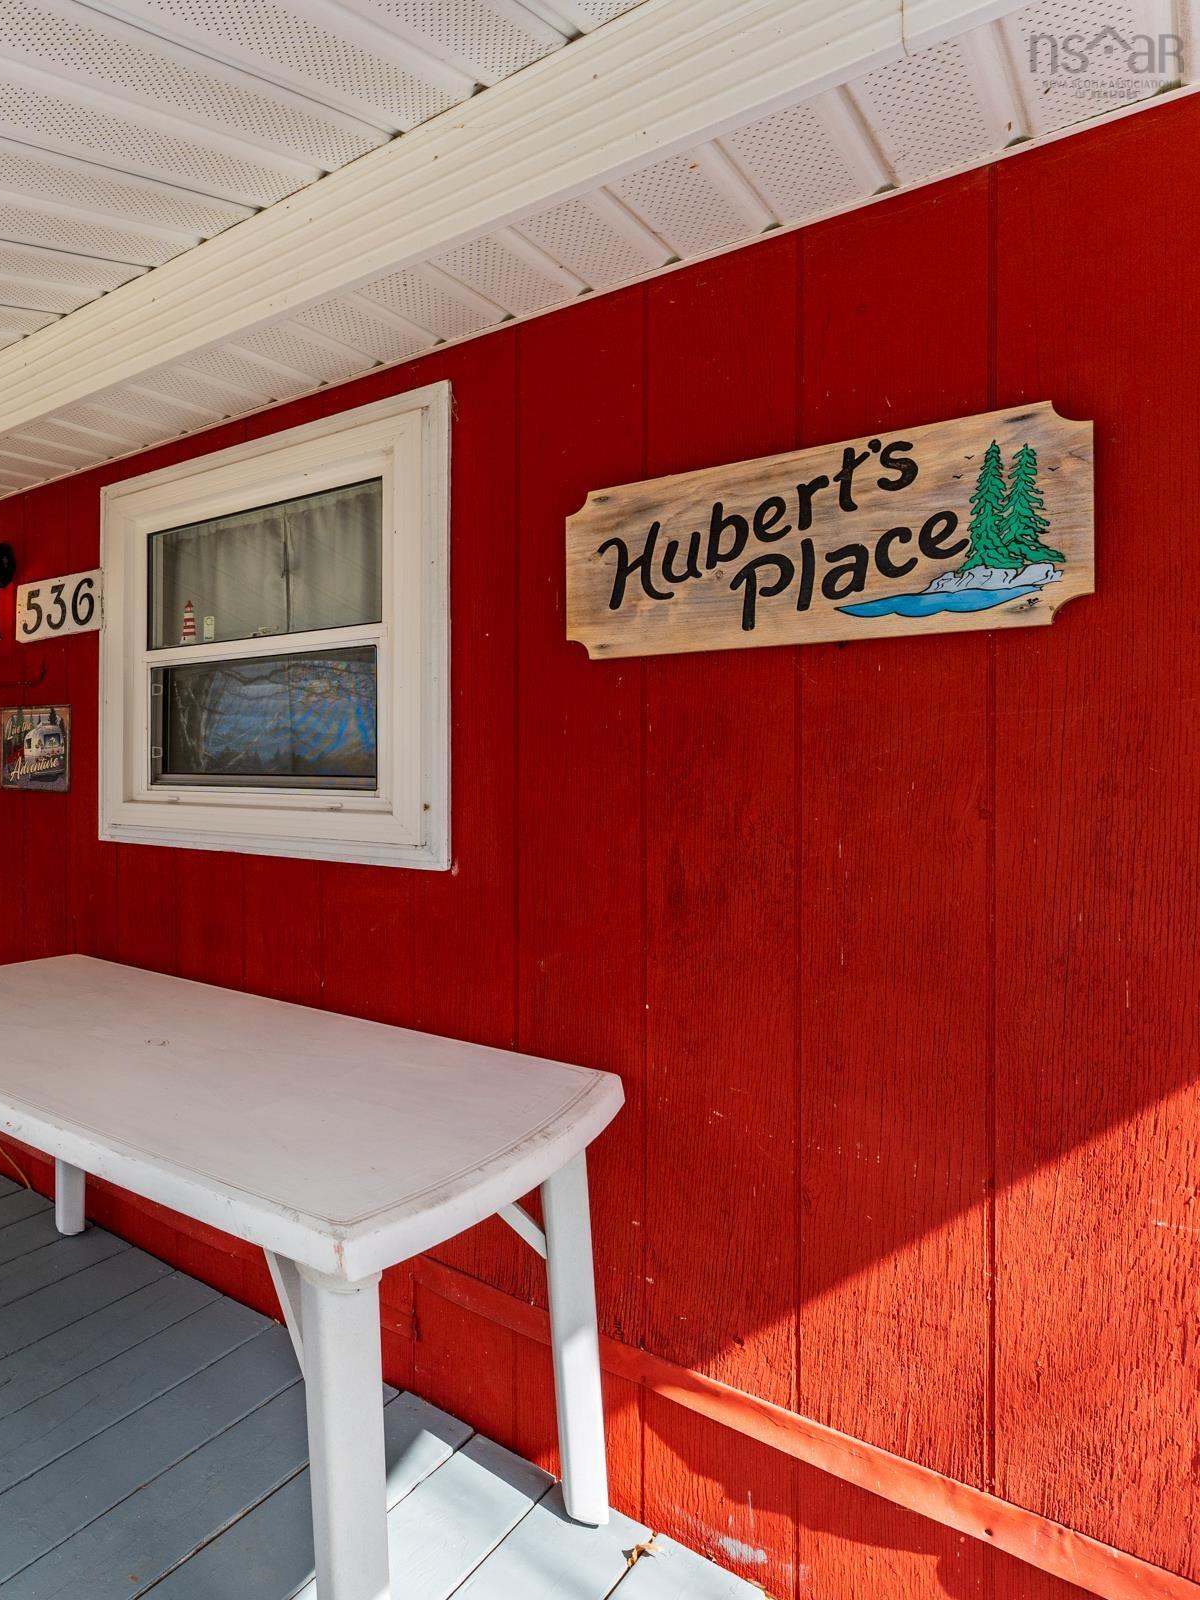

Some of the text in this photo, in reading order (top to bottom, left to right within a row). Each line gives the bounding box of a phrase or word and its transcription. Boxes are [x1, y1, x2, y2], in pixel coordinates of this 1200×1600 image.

[598, 439, 919, 610] Hubert's
[22, 577, 95, 635] 536
[5, 718, 21, 740] Live
[10, 756, 58, 781] Adventure
